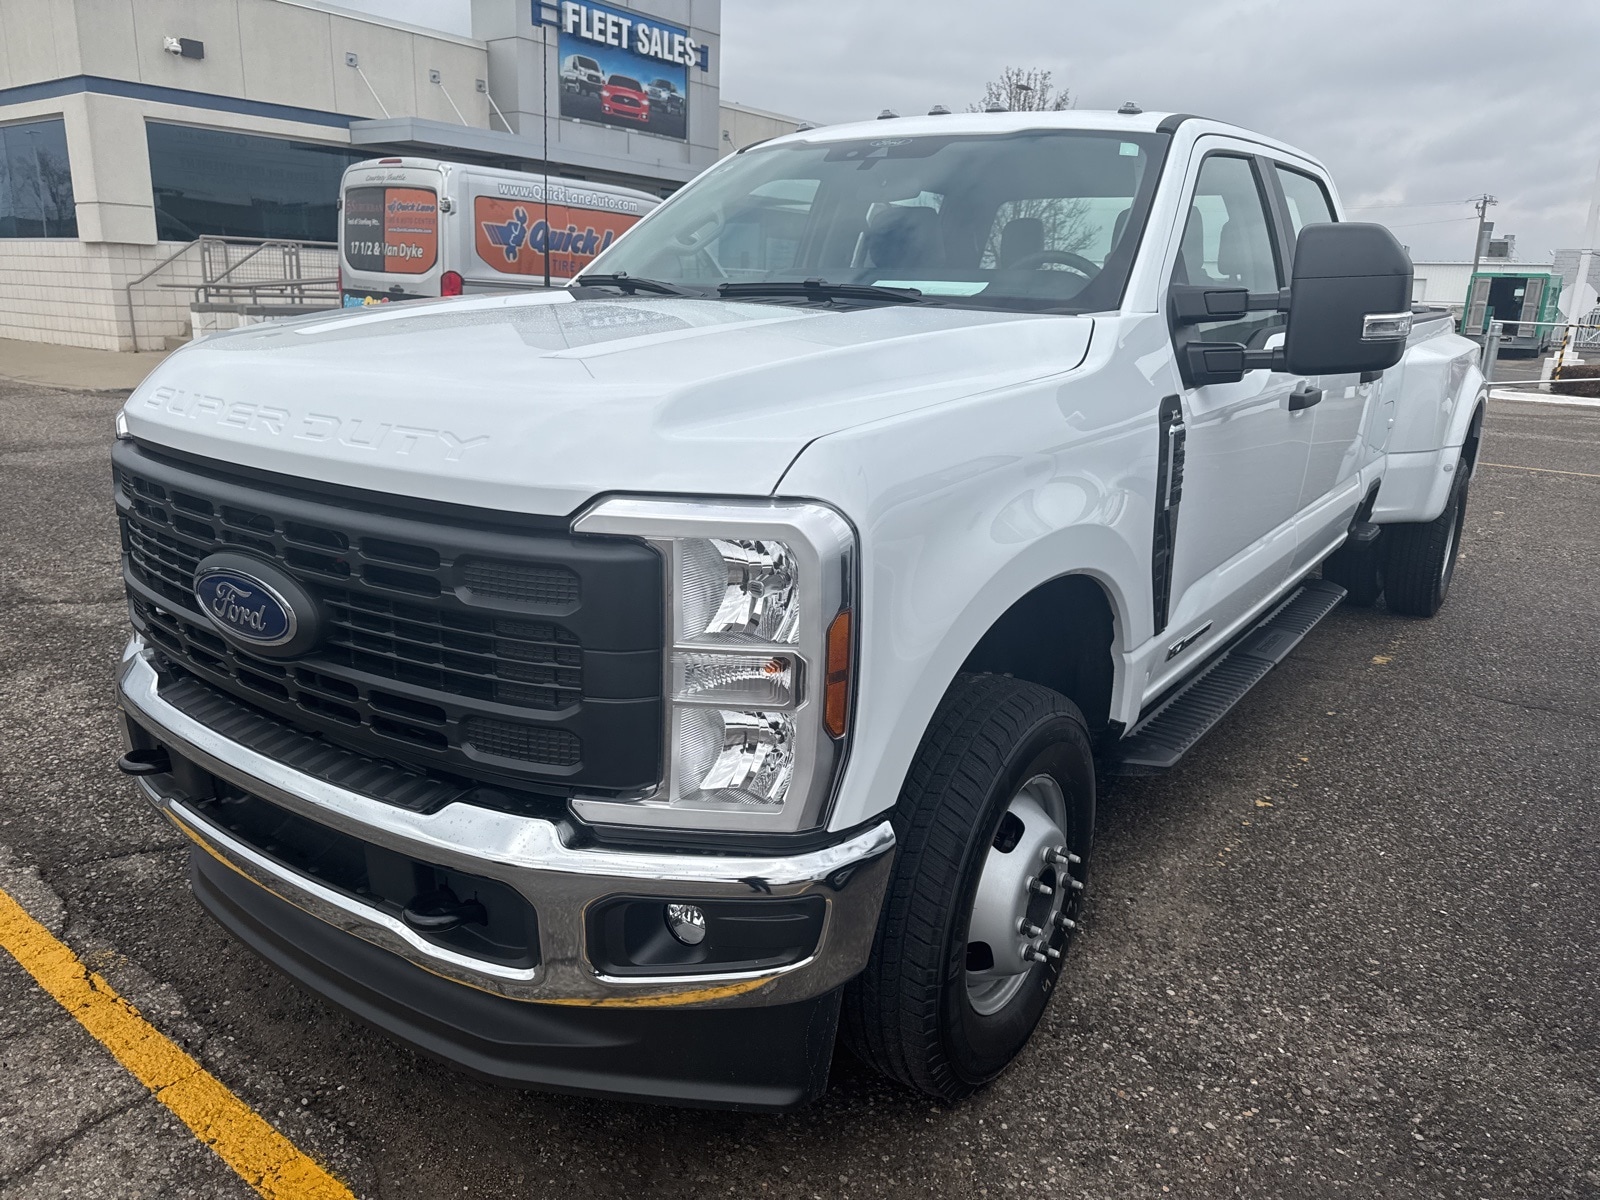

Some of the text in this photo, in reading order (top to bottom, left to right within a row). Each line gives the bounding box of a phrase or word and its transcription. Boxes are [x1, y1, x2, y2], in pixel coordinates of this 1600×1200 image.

[562, 1, 696, 67] FLEET SALES
[396, 202, 436, 212] Quick Lane
[498, 183, 638, 212] www.QuickLaneAuto.com
[351, 242, 424, 260] 17 1/2 & Van Dyke
[530, 220, 599, 255] Quick
[552, 259, 575, 272] TIRE
[143, 385, 491, 462] SUPER DUTY
[212, 580, 266, 631] Ford
